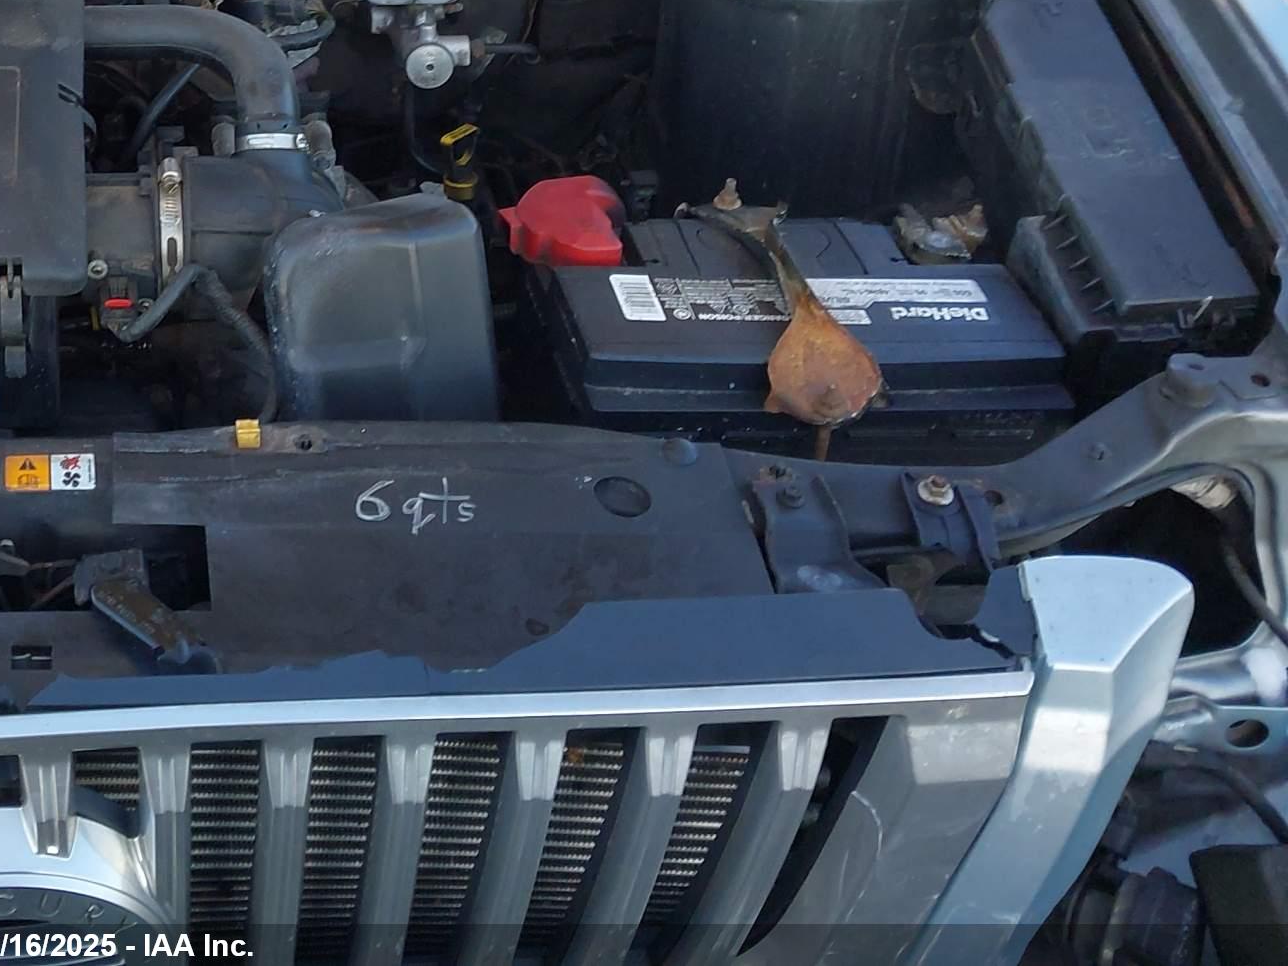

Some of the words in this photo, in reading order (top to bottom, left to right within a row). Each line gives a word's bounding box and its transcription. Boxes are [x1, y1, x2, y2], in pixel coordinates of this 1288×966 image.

[890, 306, 990, 321] DieHard
[355, 479, 395, 522] 6
[402, 477, 477, 535] qts
